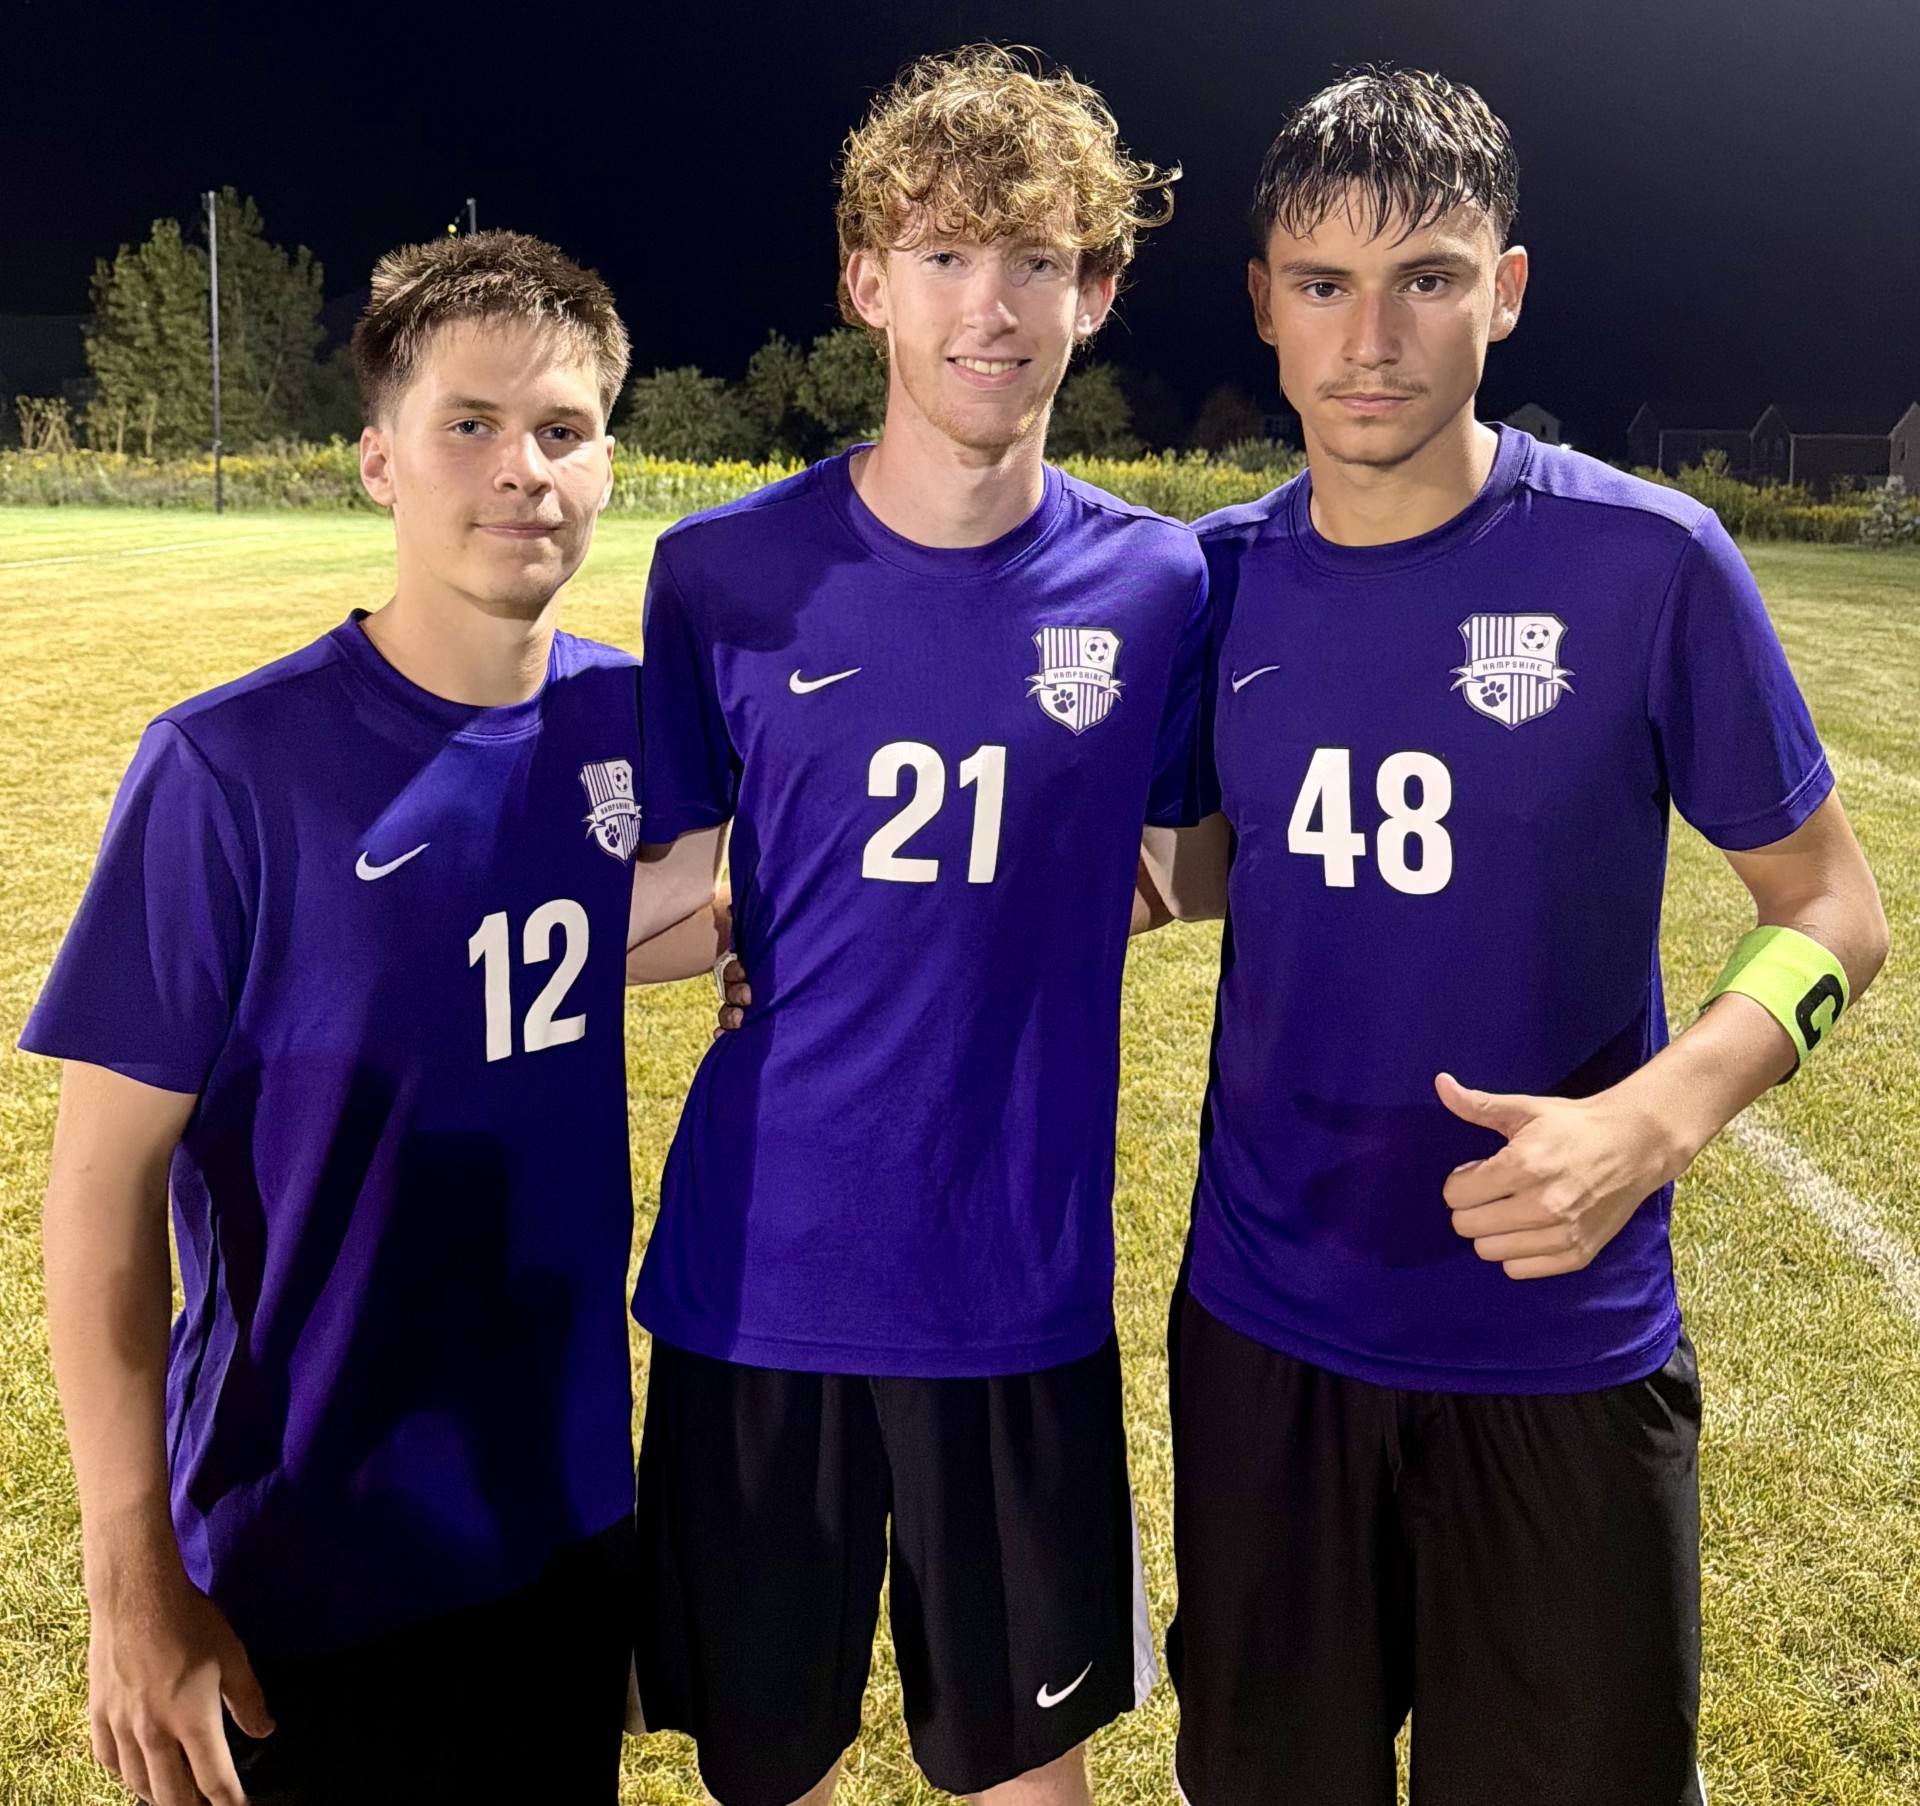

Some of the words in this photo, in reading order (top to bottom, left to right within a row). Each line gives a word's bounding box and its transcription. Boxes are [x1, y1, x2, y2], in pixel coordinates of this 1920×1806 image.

[1053, 670, 1104, 682] HAMPSHIRE
[1482, 660, 1543, 672] HAMPSHIRE
[861, 741, 1007, 884] 21
[1287, 747, 1453, 895] 48
[468, 898, 590, 1063] 12
[1795, 973, 1844, 1051] C
